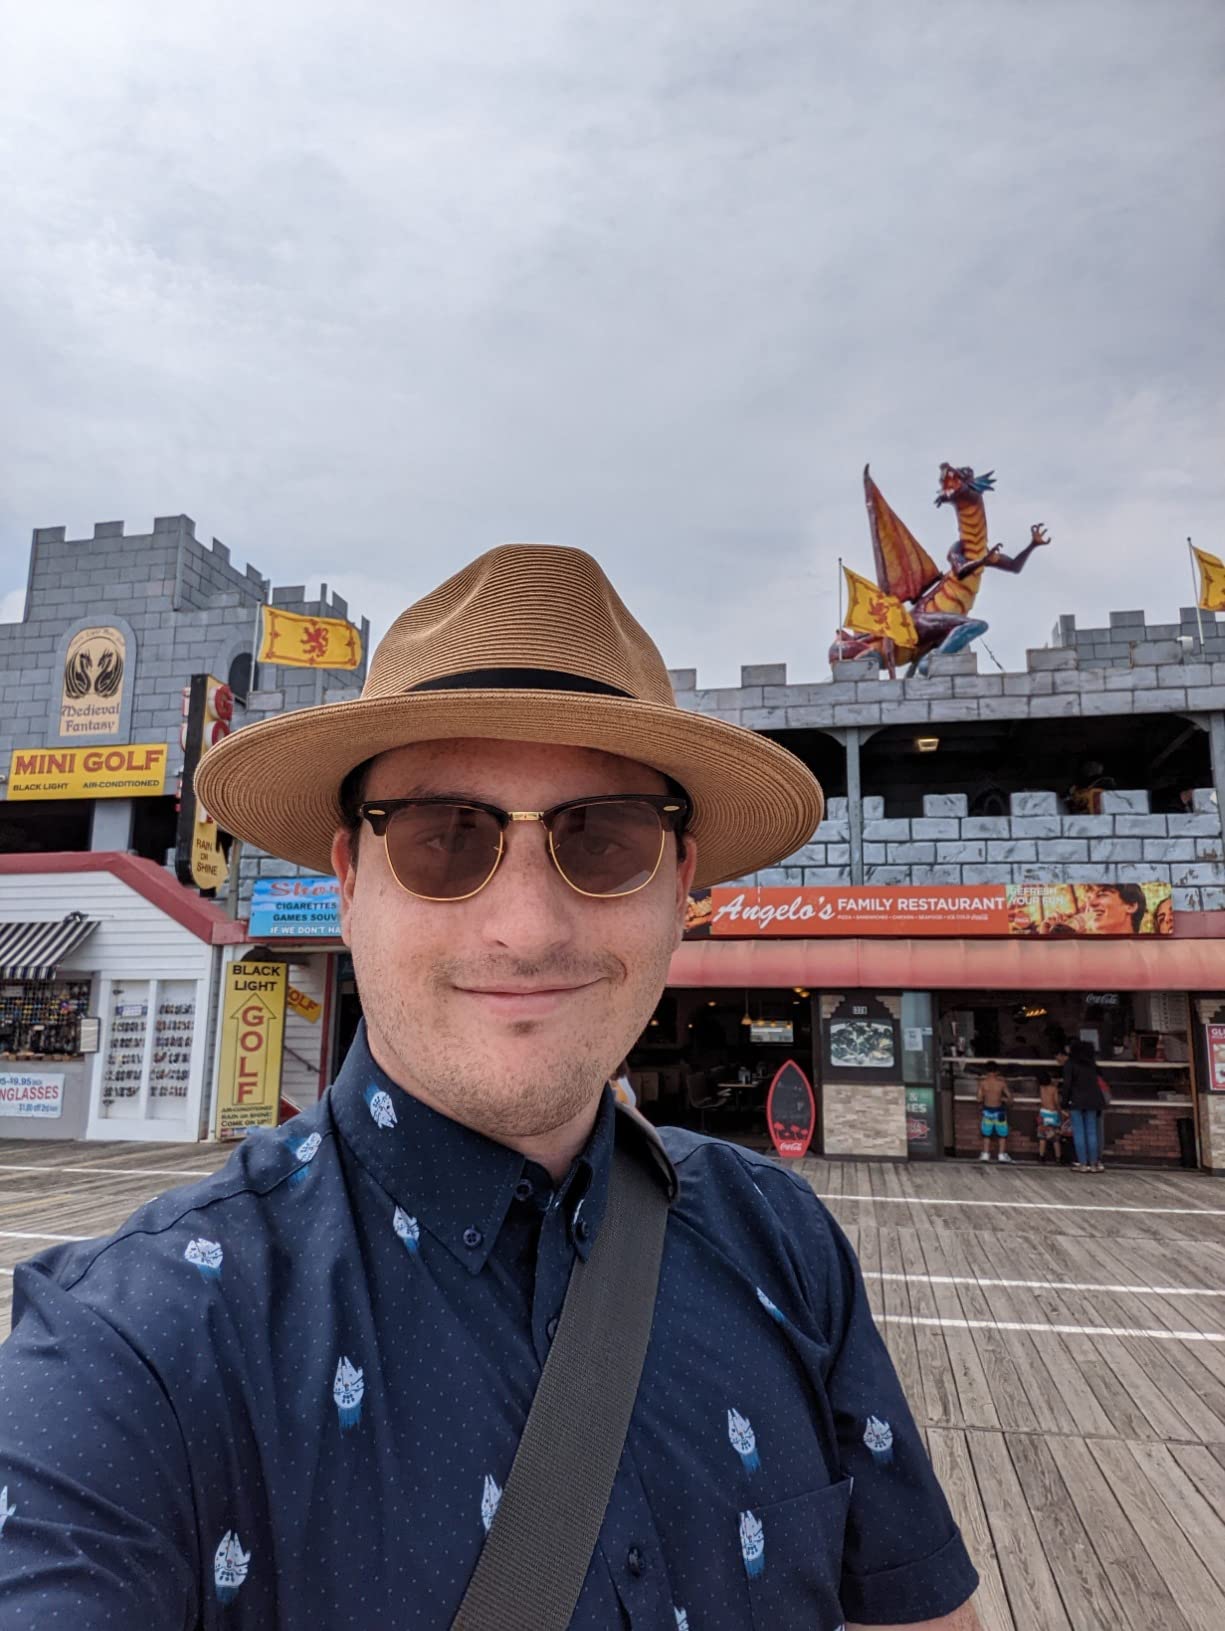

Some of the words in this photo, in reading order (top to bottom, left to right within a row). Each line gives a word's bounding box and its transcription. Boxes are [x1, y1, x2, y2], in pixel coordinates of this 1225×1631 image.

[62, 702, 120, 717] Medieval
[66, 720, 115, 734] Fantasy
[15, 753, 76, 776] MINI
[83, 749, 164, 773] GOLF
[13, 783, 41, 791] BLACK
[43, 782, 69, 790] LIGHT
[83, 780, 160, 789] AIR-CONDITIONED
[196, 838, 213, 851] RAIN
[196, 862, 218, 876] SHINE
[276, 901, 337, 911] CIGARETTES
[713, 893, 835, 929] Angelo's
[838, 898, 893, 911] FAMILY
[898, 897, 1005, 911] RESTAURANT
[273, 913, 308, 922] GAMES
[270, 926, 280, 934] IF
[281, 926, 296, 934] WE
[298, 926, 325, 934] DON'T
[232, 965, 280, 977] BLACK
[234, 980, 277, 992] LIGHT
[287, 985, 318, 1011] OLF
[237, 1005, 264, 1104] GOLF
